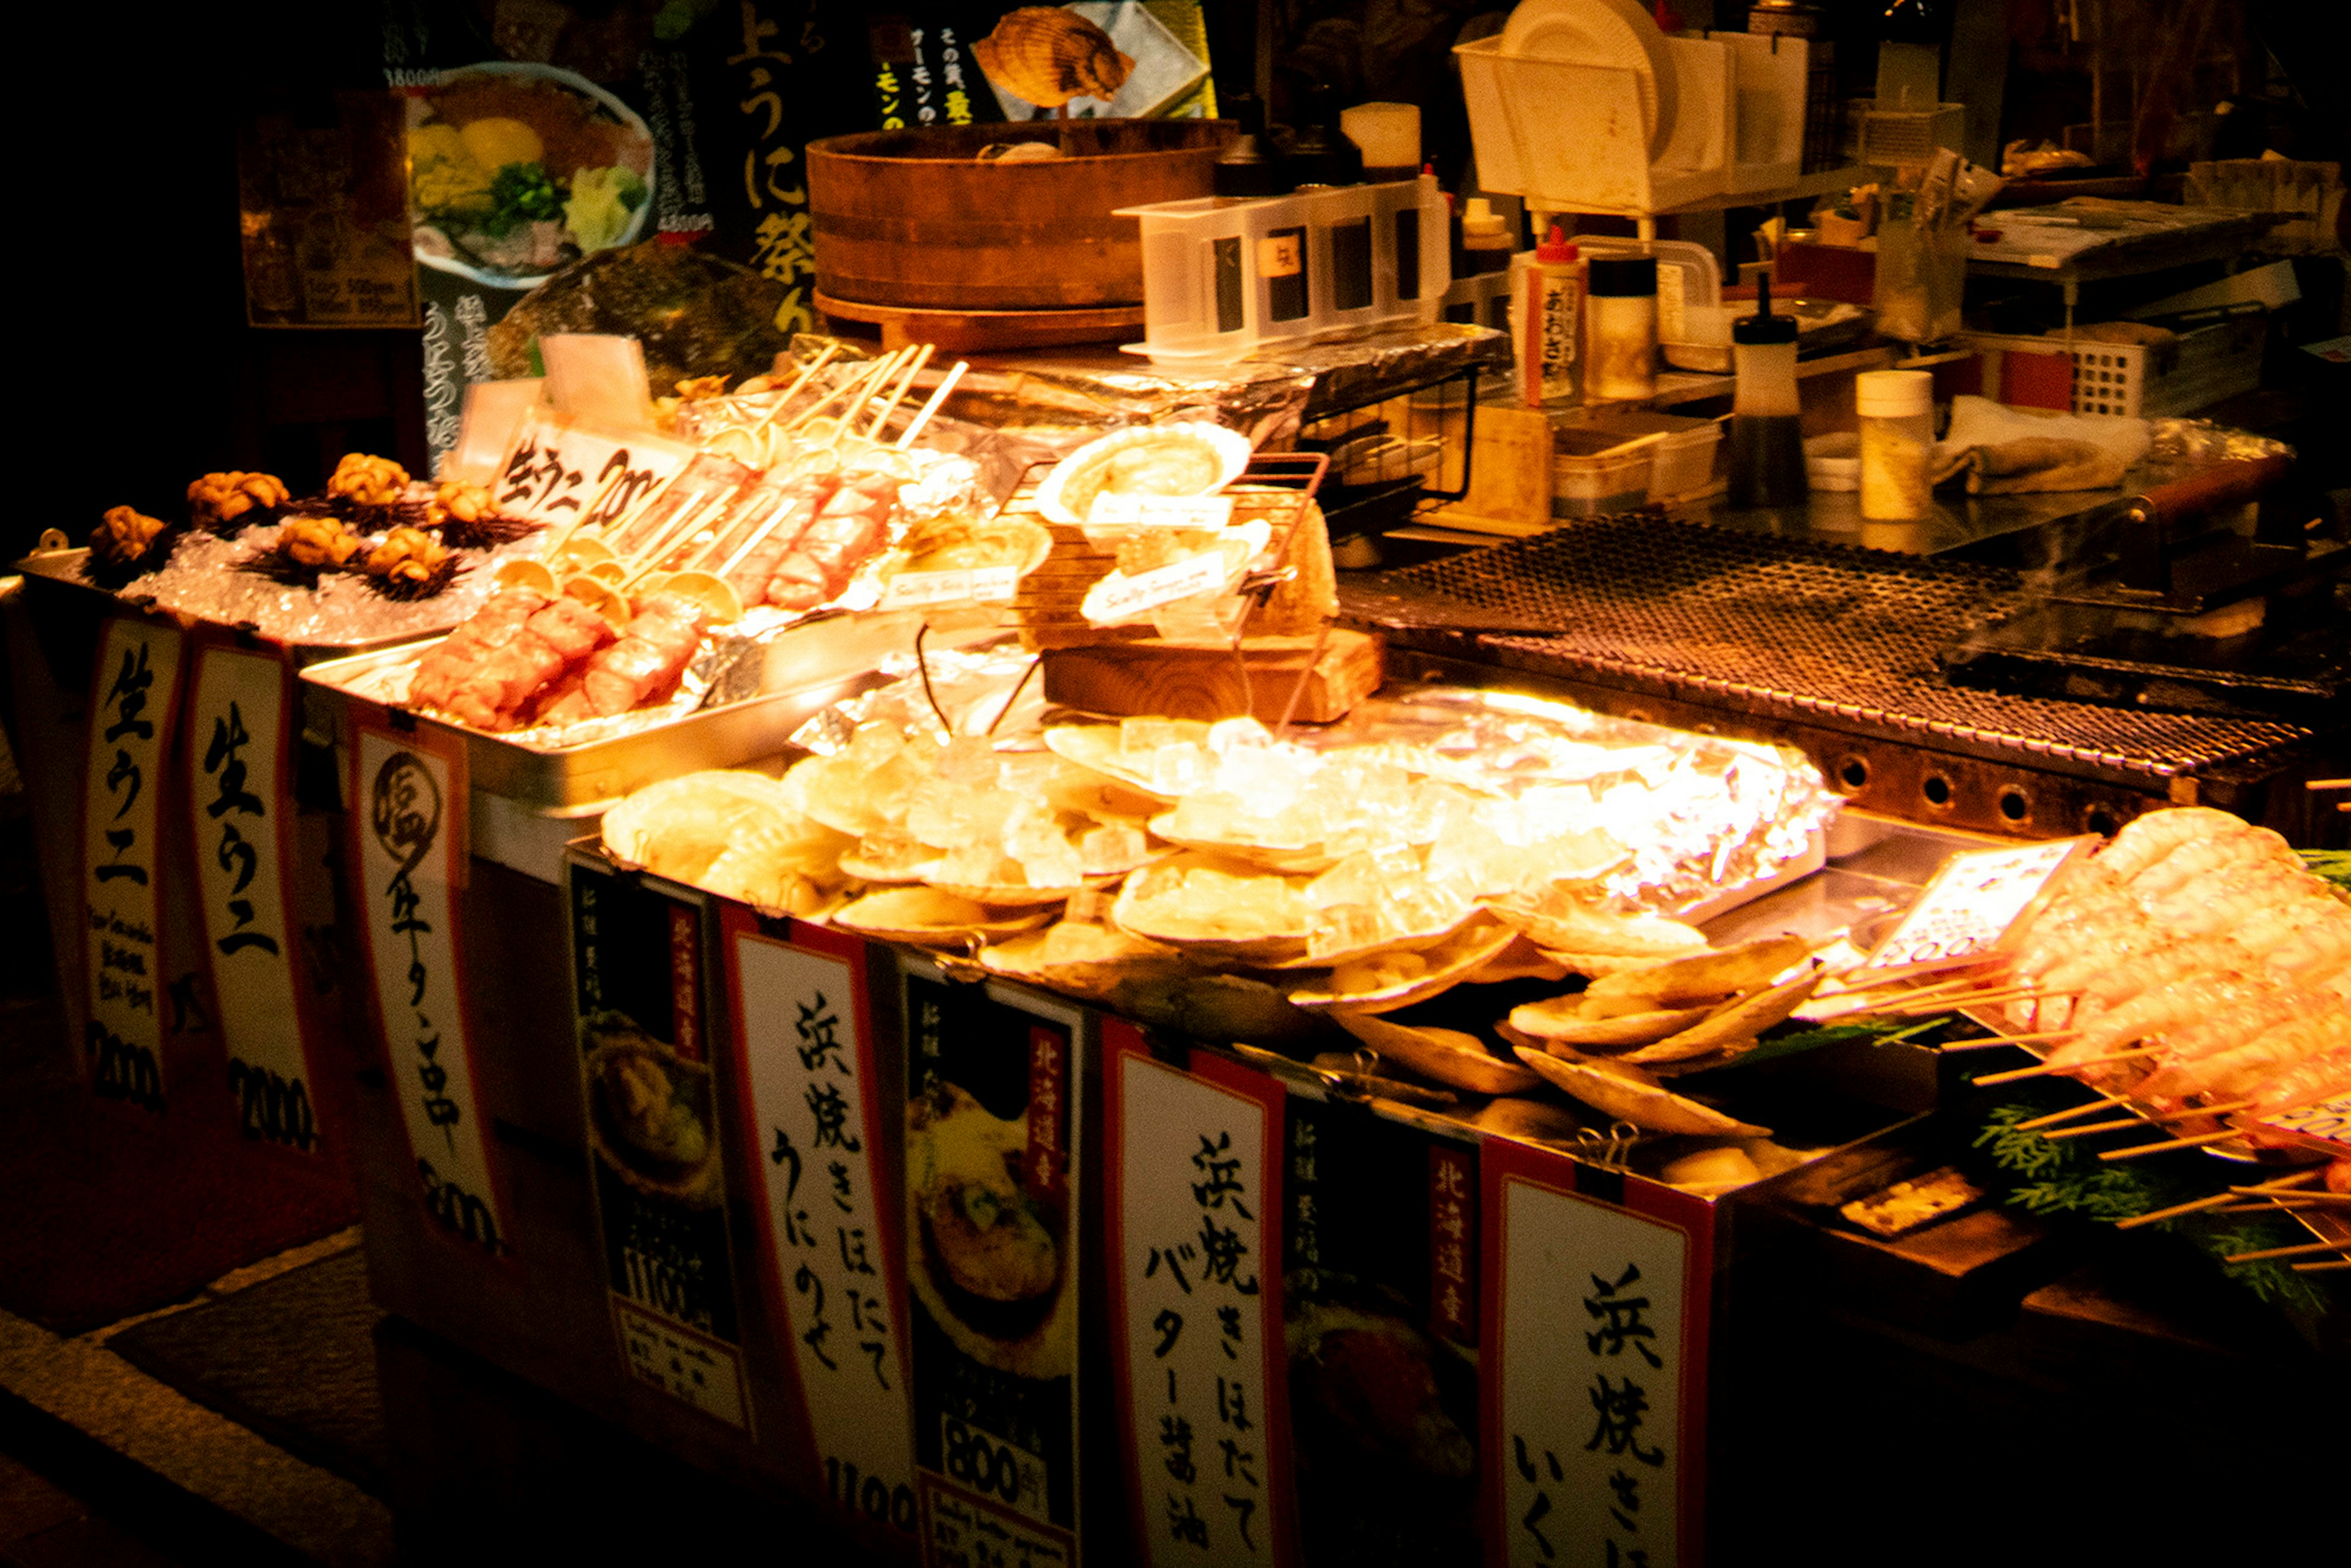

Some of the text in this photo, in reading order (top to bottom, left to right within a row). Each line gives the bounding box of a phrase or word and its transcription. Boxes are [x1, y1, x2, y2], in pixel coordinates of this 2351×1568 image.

[772, 1127, 836, 1370] うにのせ
[795, 992, 890, 1390] 浜焼きほたて
[1436, 1160, 1466, 1326] 北海道産
[1192, 1132, 1258, 1552] 浜焼きほたて
[826, 1457, 915, 1532] 1100
[1514, 1435, 1563, 1568] いく
